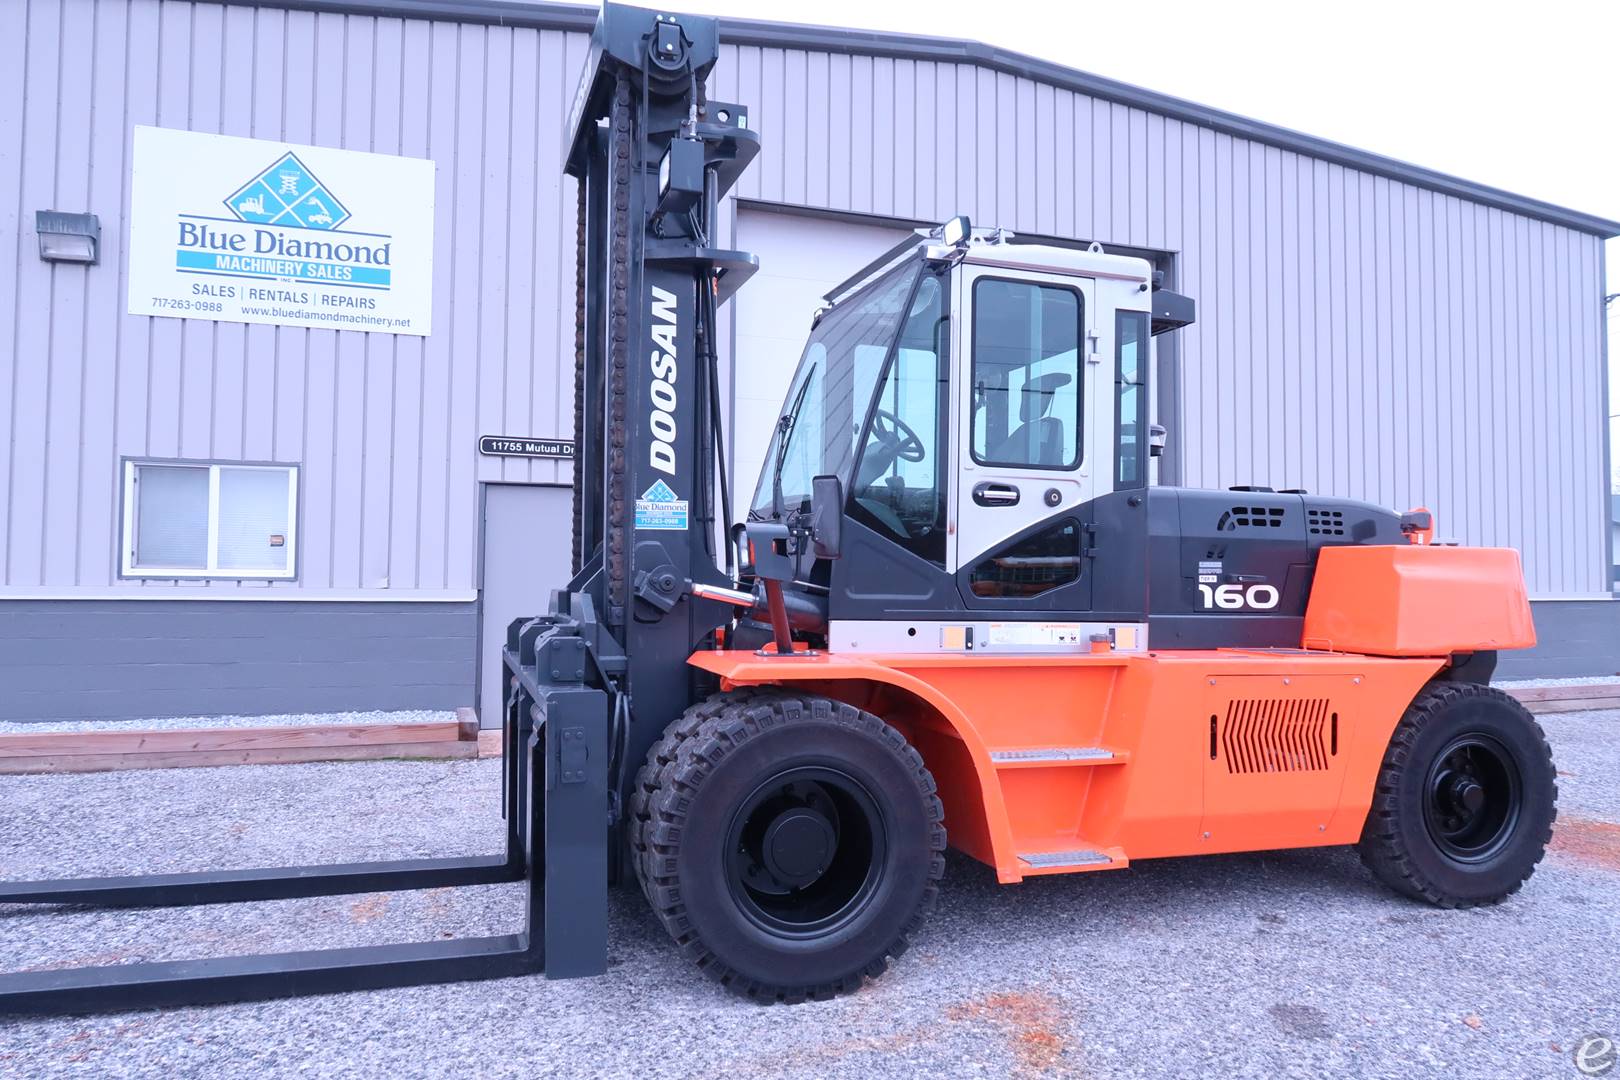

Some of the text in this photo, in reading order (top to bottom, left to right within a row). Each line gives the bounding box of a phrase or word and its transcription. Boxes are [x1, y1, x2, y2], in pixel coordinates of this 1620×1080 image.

[178, 222, 391, 265] Blue Diamond
[215, 254, 352, 280] MACHINERY SALES
[152, 297, 223, 312] 717-263-0988
[192, 283, 376, 310] SALES RENTALS REPAIRS
[241, 305, 411, 328] www.bluediamondmachinery.net
[650, 285, 677, 475] DOOSAN
[492, 441, 522, 451] 11755
[526, 443, 560, 453] Mutual
[651, 503, 687, 511] Diamond
[1198, 583, 1279, 609] 160
